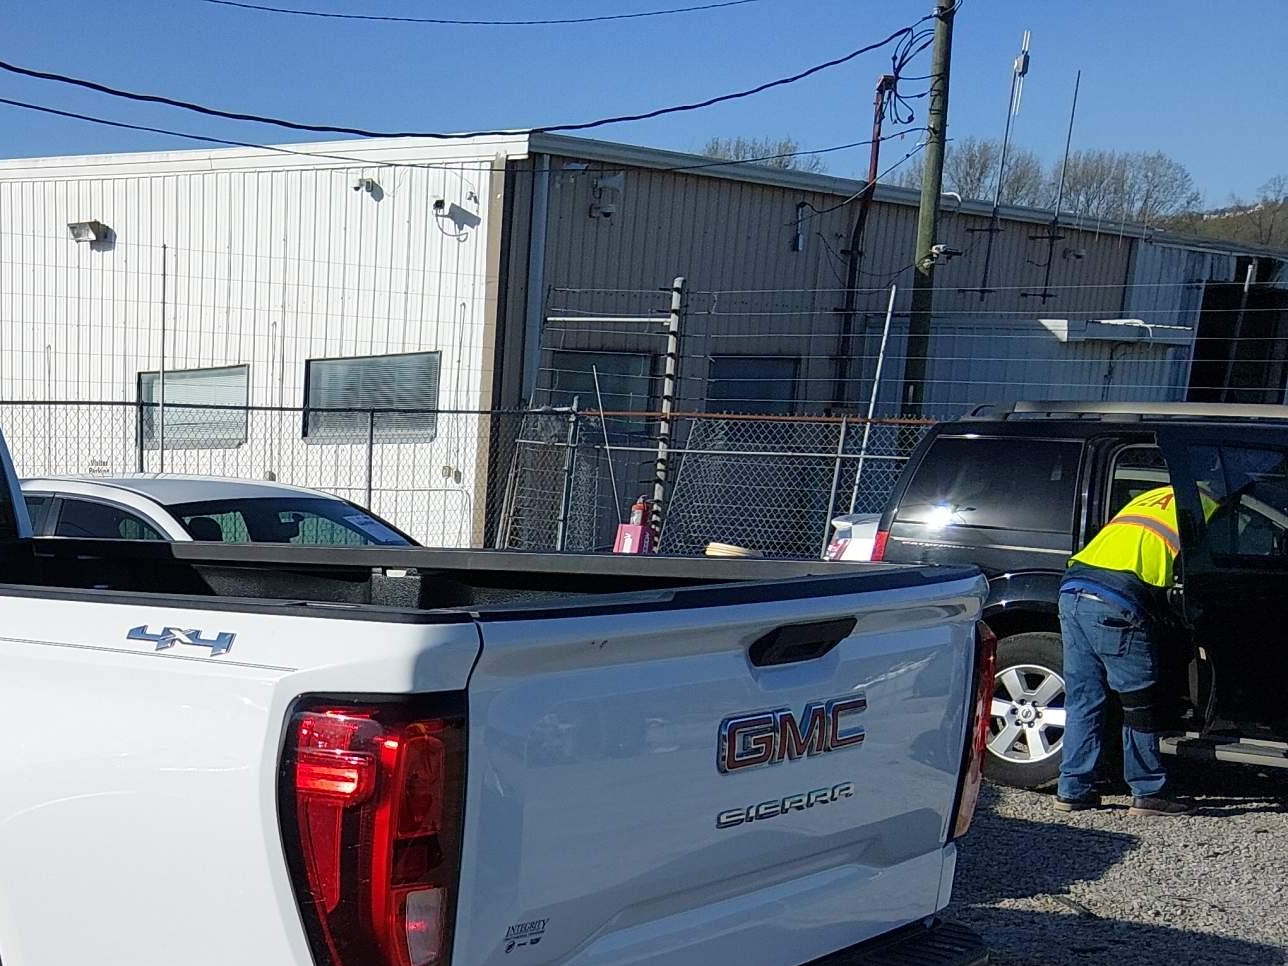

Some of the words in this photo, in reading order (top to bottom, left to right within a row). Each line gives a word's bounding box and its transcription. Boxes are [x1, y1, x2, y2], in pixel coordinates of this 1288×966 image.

[717, 692, 868, 775] GMC
[716, 781, 856, 829] SIERRA
[505, 919, 547, 937] INTEGRITY
